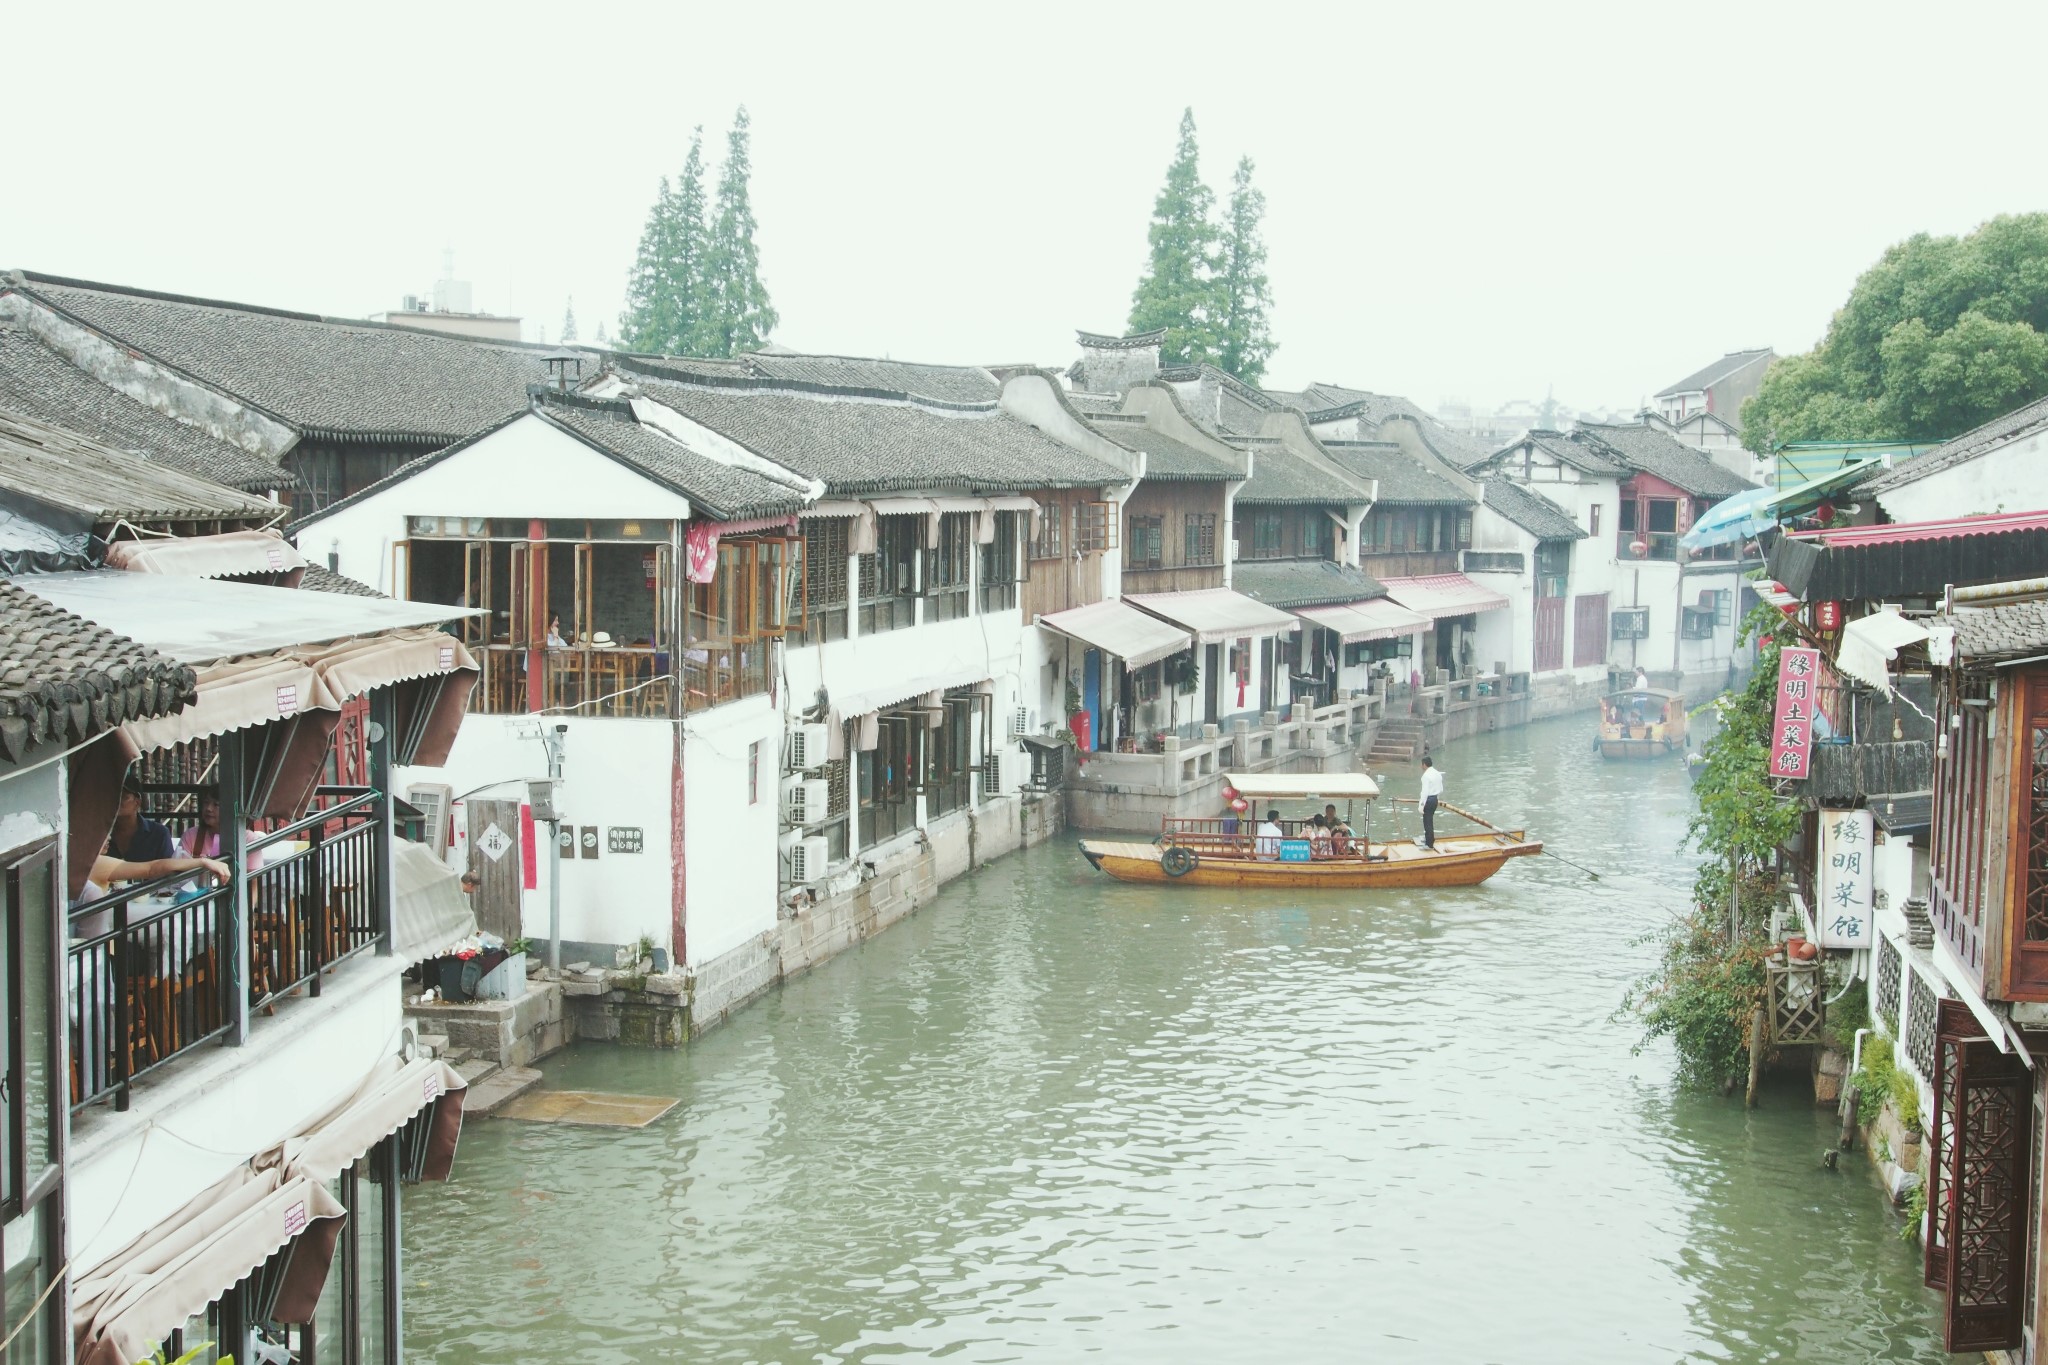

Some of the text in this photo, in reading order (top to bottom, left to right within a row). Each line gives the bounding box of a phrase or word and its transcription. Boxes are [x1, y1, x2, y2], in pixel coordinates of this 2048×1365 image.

[1778, 653, 1812, 772] 緣明土菜館
[488, 834, 502, 850] 福
[611, 840, 641, 850] 当心落水
[1827, 819, 1866, 938] 缘明菜馆
